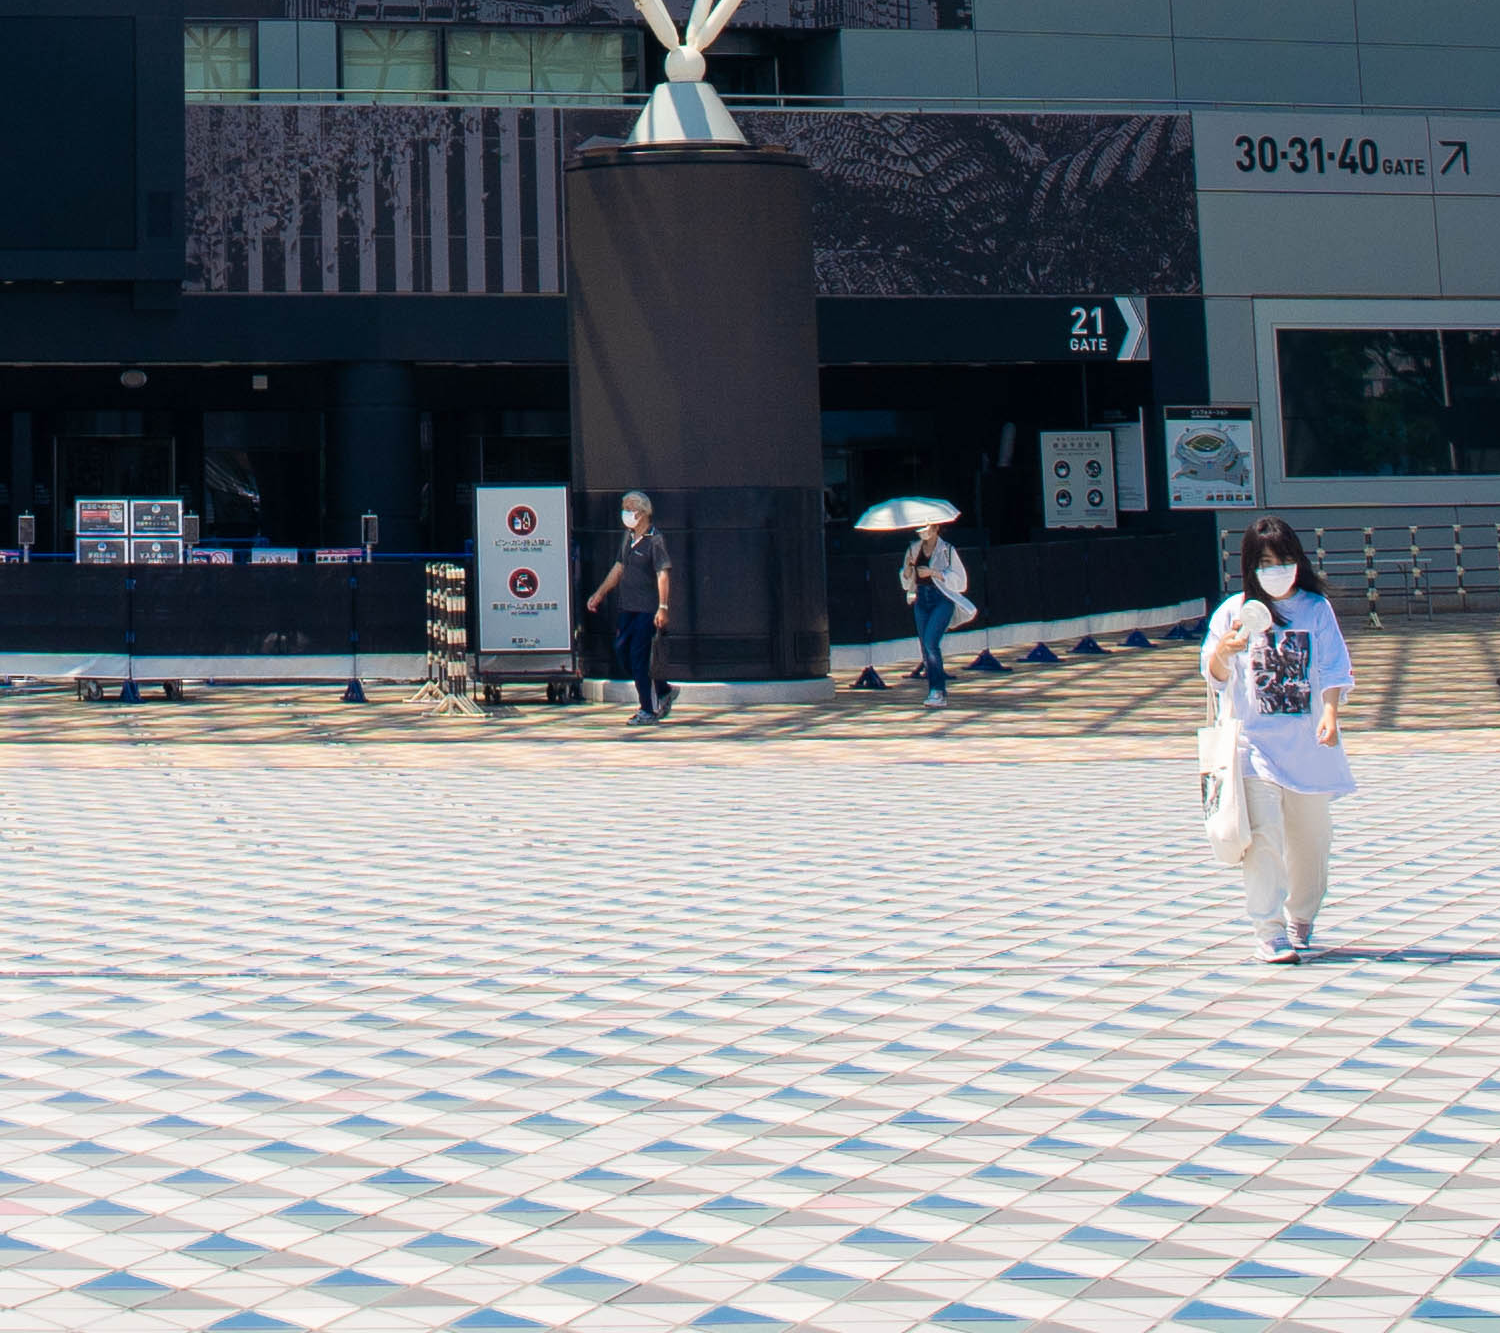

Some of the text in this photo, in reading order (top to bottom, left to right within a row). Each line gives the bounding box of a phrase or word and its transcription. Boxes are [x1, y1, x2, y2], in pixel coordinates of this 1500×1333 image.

[1382, 158, 1426, 175] GATE
[1070, 306, 1103, 335] 21
[1070, 338, 1108, 351] GATE
